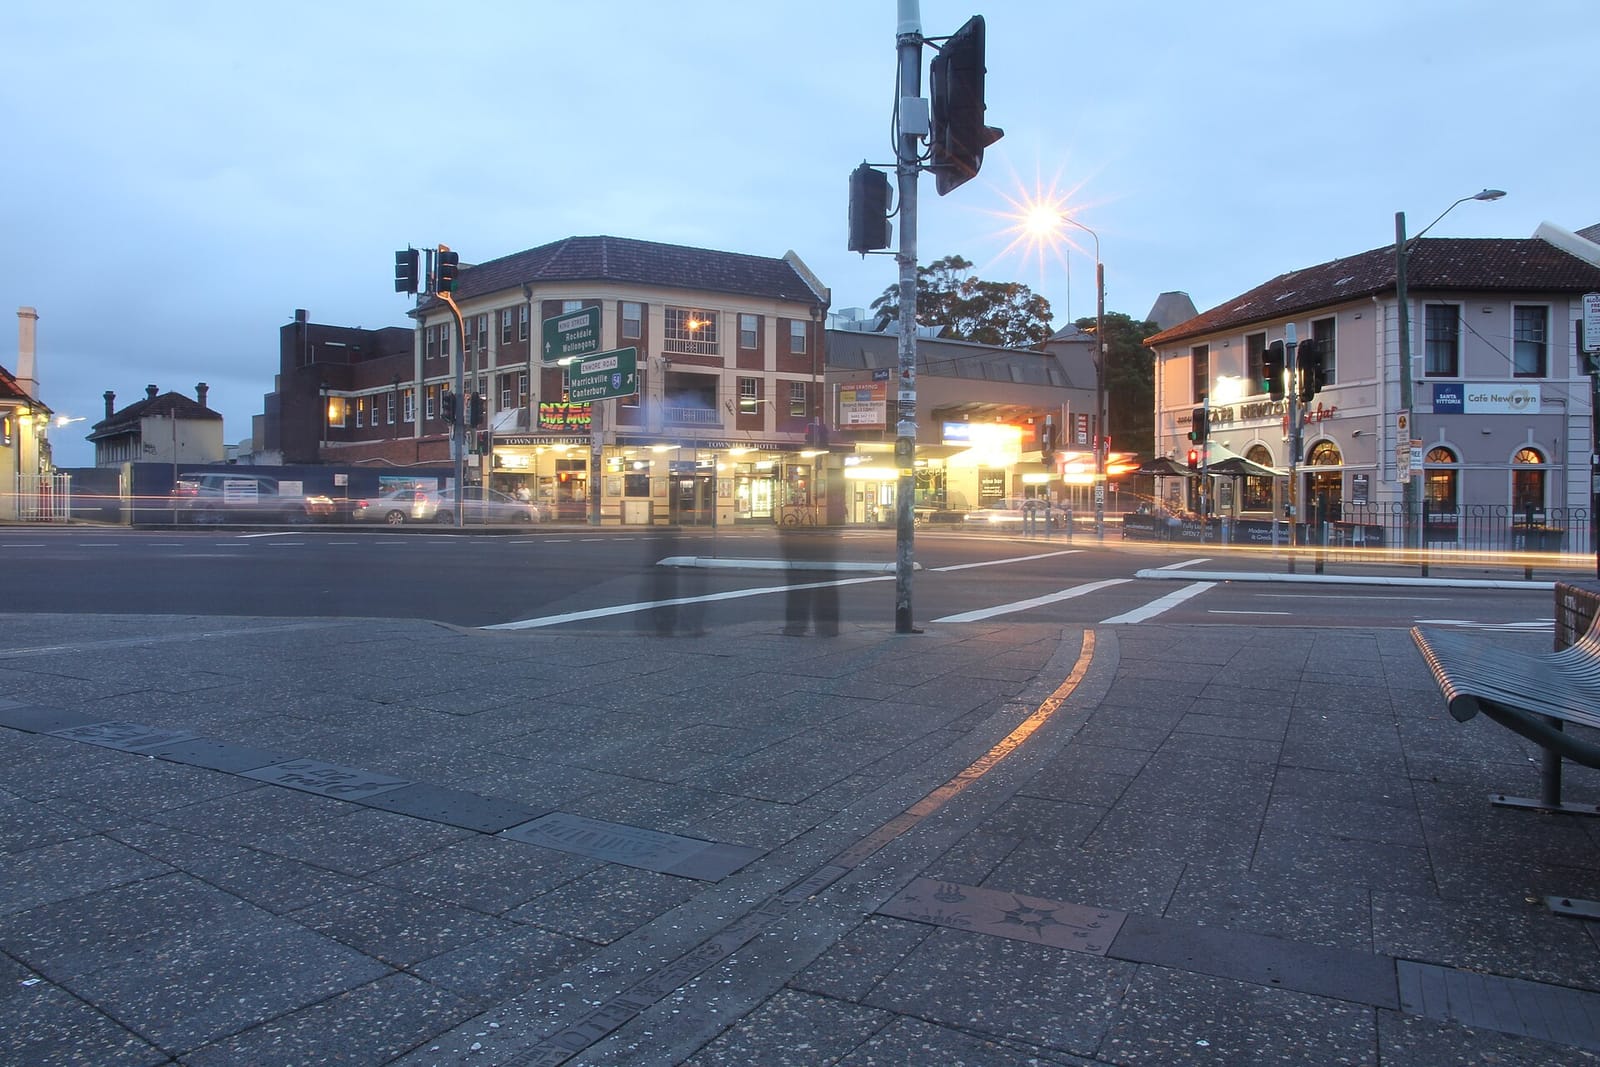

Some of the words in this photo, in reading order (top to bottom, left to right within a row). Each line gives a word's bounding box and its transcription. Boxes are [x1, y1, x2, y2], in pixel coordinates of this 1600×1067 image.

[572, 315, 588, 328] STREET
[566, 329, 592, 341] Rockdale
[562, 339, 596, 353] Wollongong
[582, 361, 601, 373] ENMORE
[602, 359, 617, 369] ROAD
[571, 374, 608, 388] Marrickville
[572, 386, 607, 398] Canterbury
[1468, 393, 1488, 403] Café
[1490, 394, 1537, 404] Newtown
[566, 412, 592, 424] MUS
[559, 437, 590, 445] HOTEL
[754, 442, 779, 450] HOTEL
